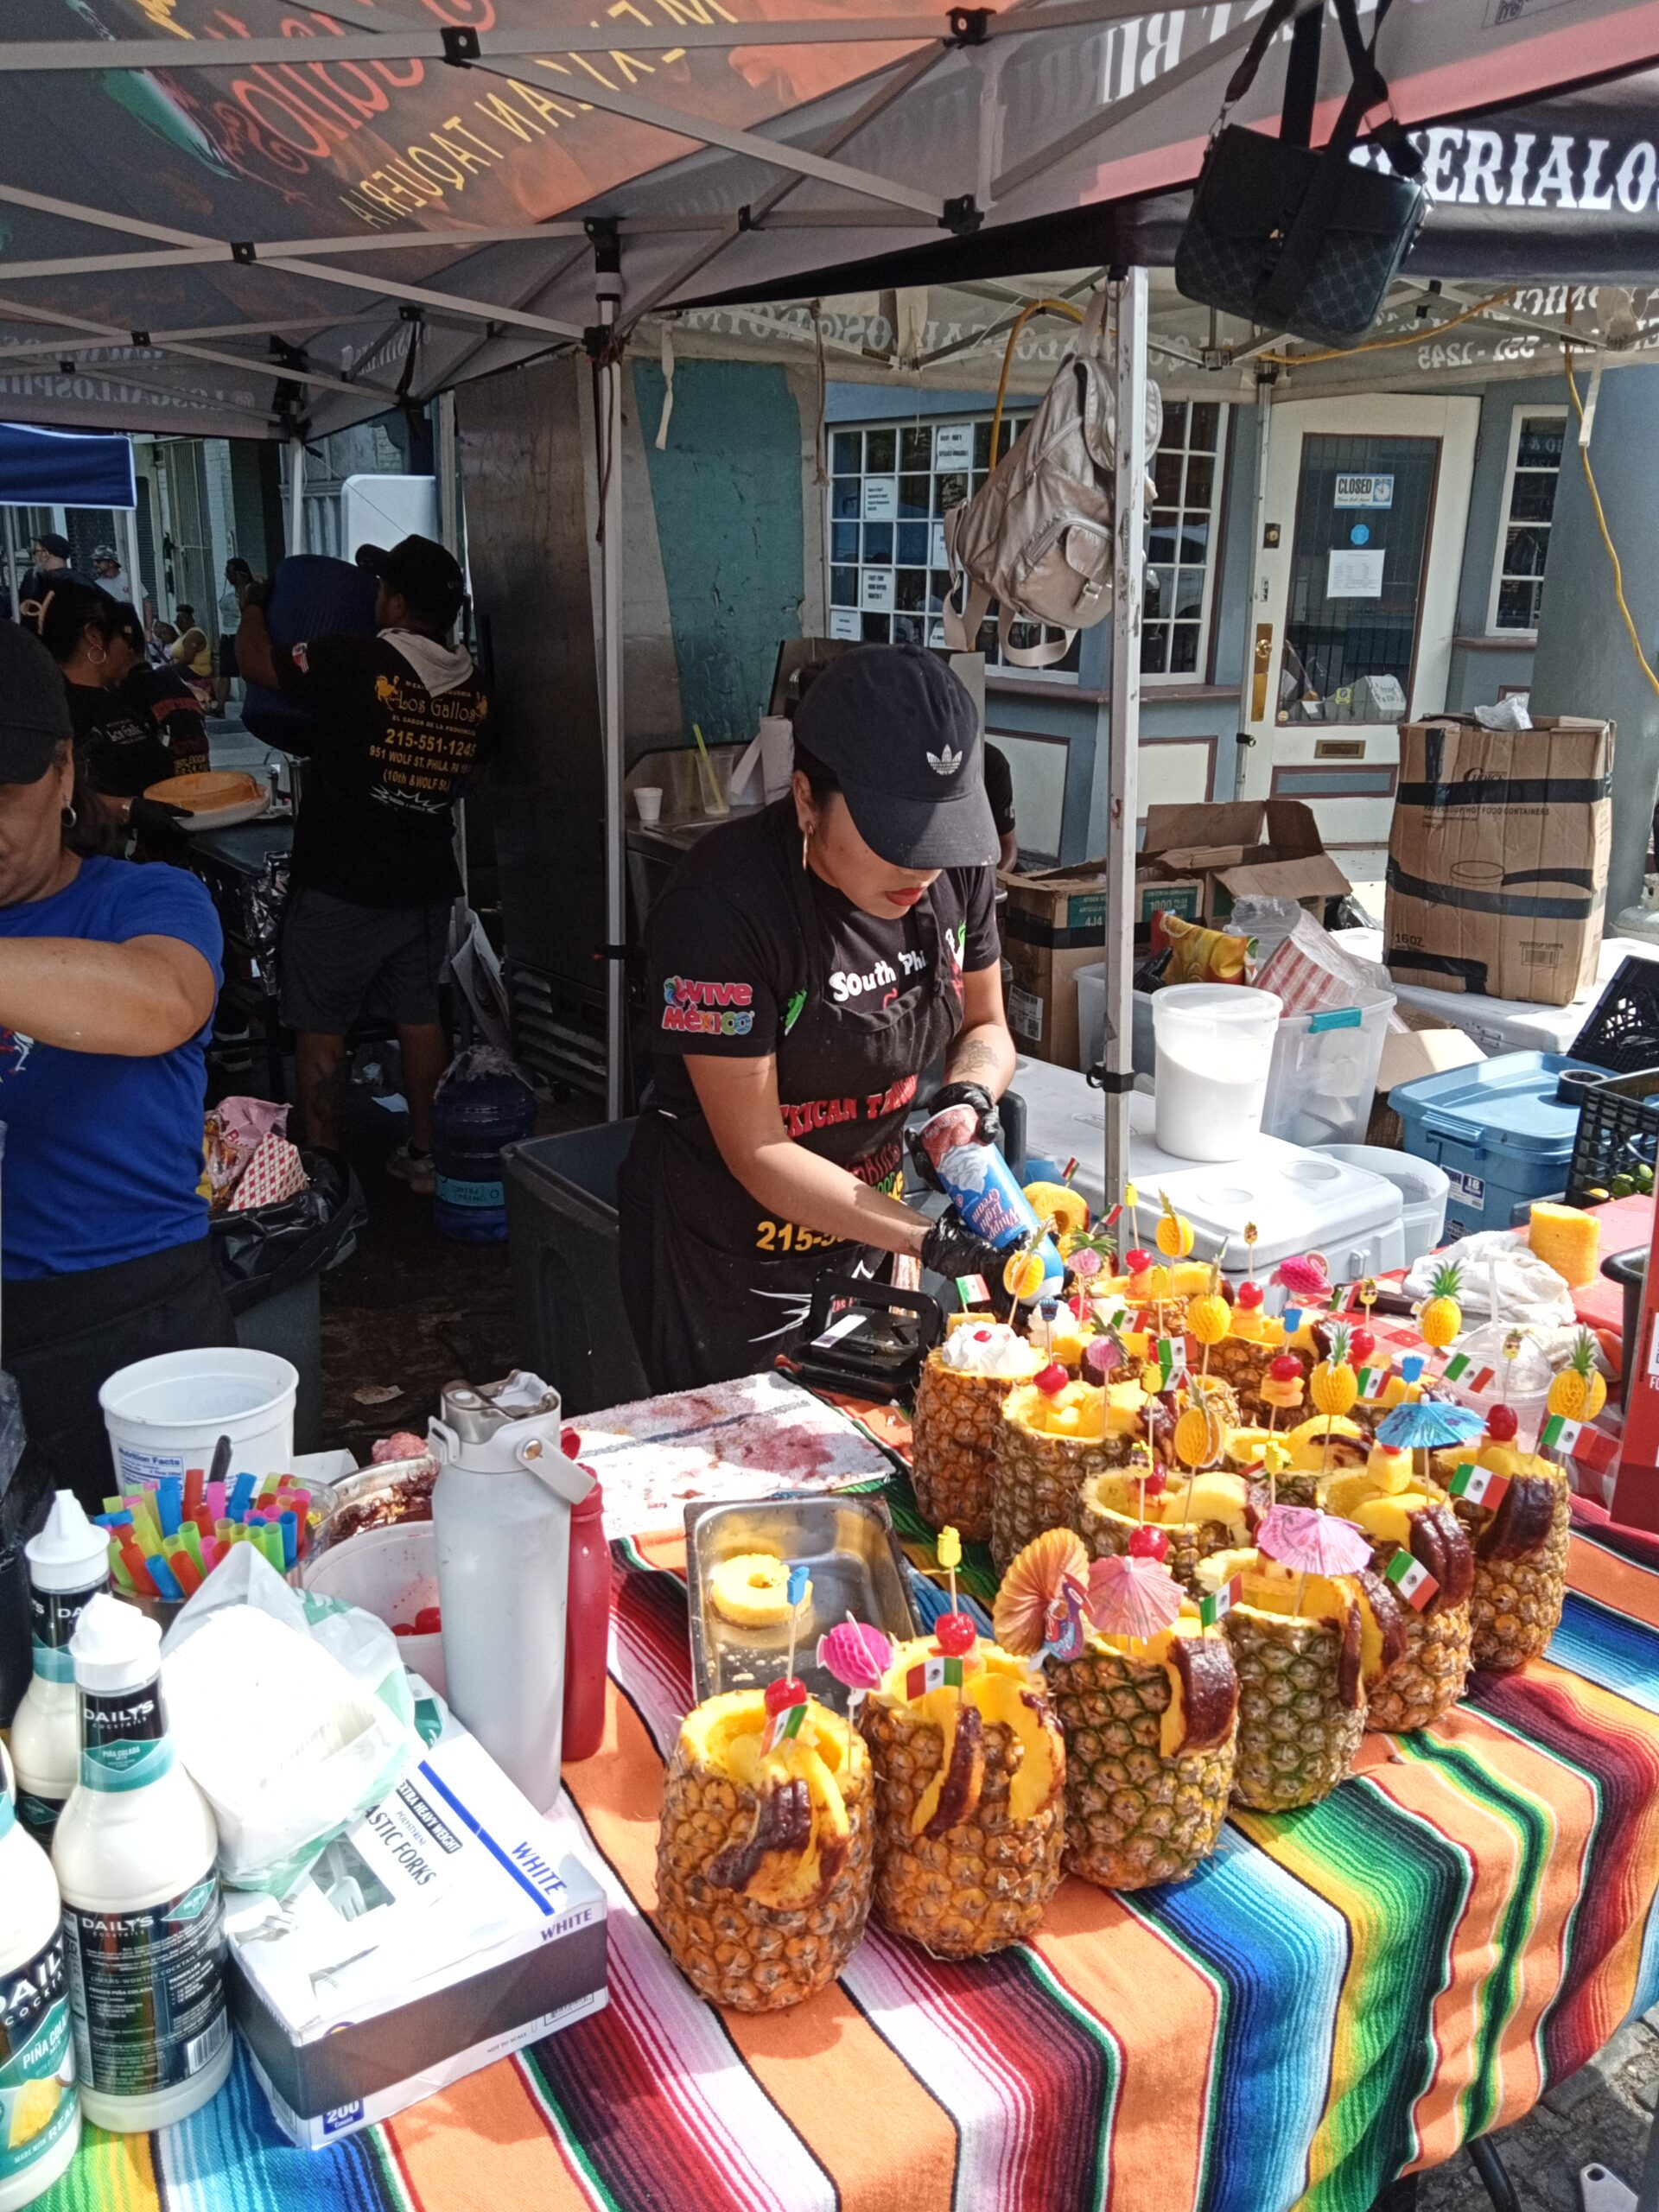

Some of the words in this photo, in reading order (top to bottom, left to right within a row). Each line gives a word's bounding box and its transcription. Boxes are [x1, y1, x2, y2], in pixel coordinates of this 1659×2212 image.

[1338, 478, 1372, 494] CLOSED
[369, 745, 386, 760] 951
[389, 750, 413, 765] WOLF
[1482, 807, 1503, 816] FOOD
[1504, 807, 1550, 817] CONTAINERS
[829, 960, 898, 1002] South
[779, 1097, 857, 1139] EXICAN
[1468, 1177, 1480, 1190] 18
[118, 1447, 150, 1464] Nutrition
[152, 1456, 181, 1466] Facts
[83, 1700, 155, 1720] DAILY'S
[414, 1801, 439, 1831] HEAVY
[431, 1821, 462, 1853] WEIGHT
[364, 1803, 396, 1847] ASTIC
[391, 1841, 437, 1885] FORKS
[511, 1840, 568, 1897] WHITE
[81, 1916, 156, 1933] DAILY'S
[540, 1908, 593, 1942] WHITE
[160, 1956, 195, 1976] COCKTAIL
[22, 2040, 49, 2070] PIÑA
[326, 2100, 359, 2124] 200
[334, 2114, 354, 2130] Count
